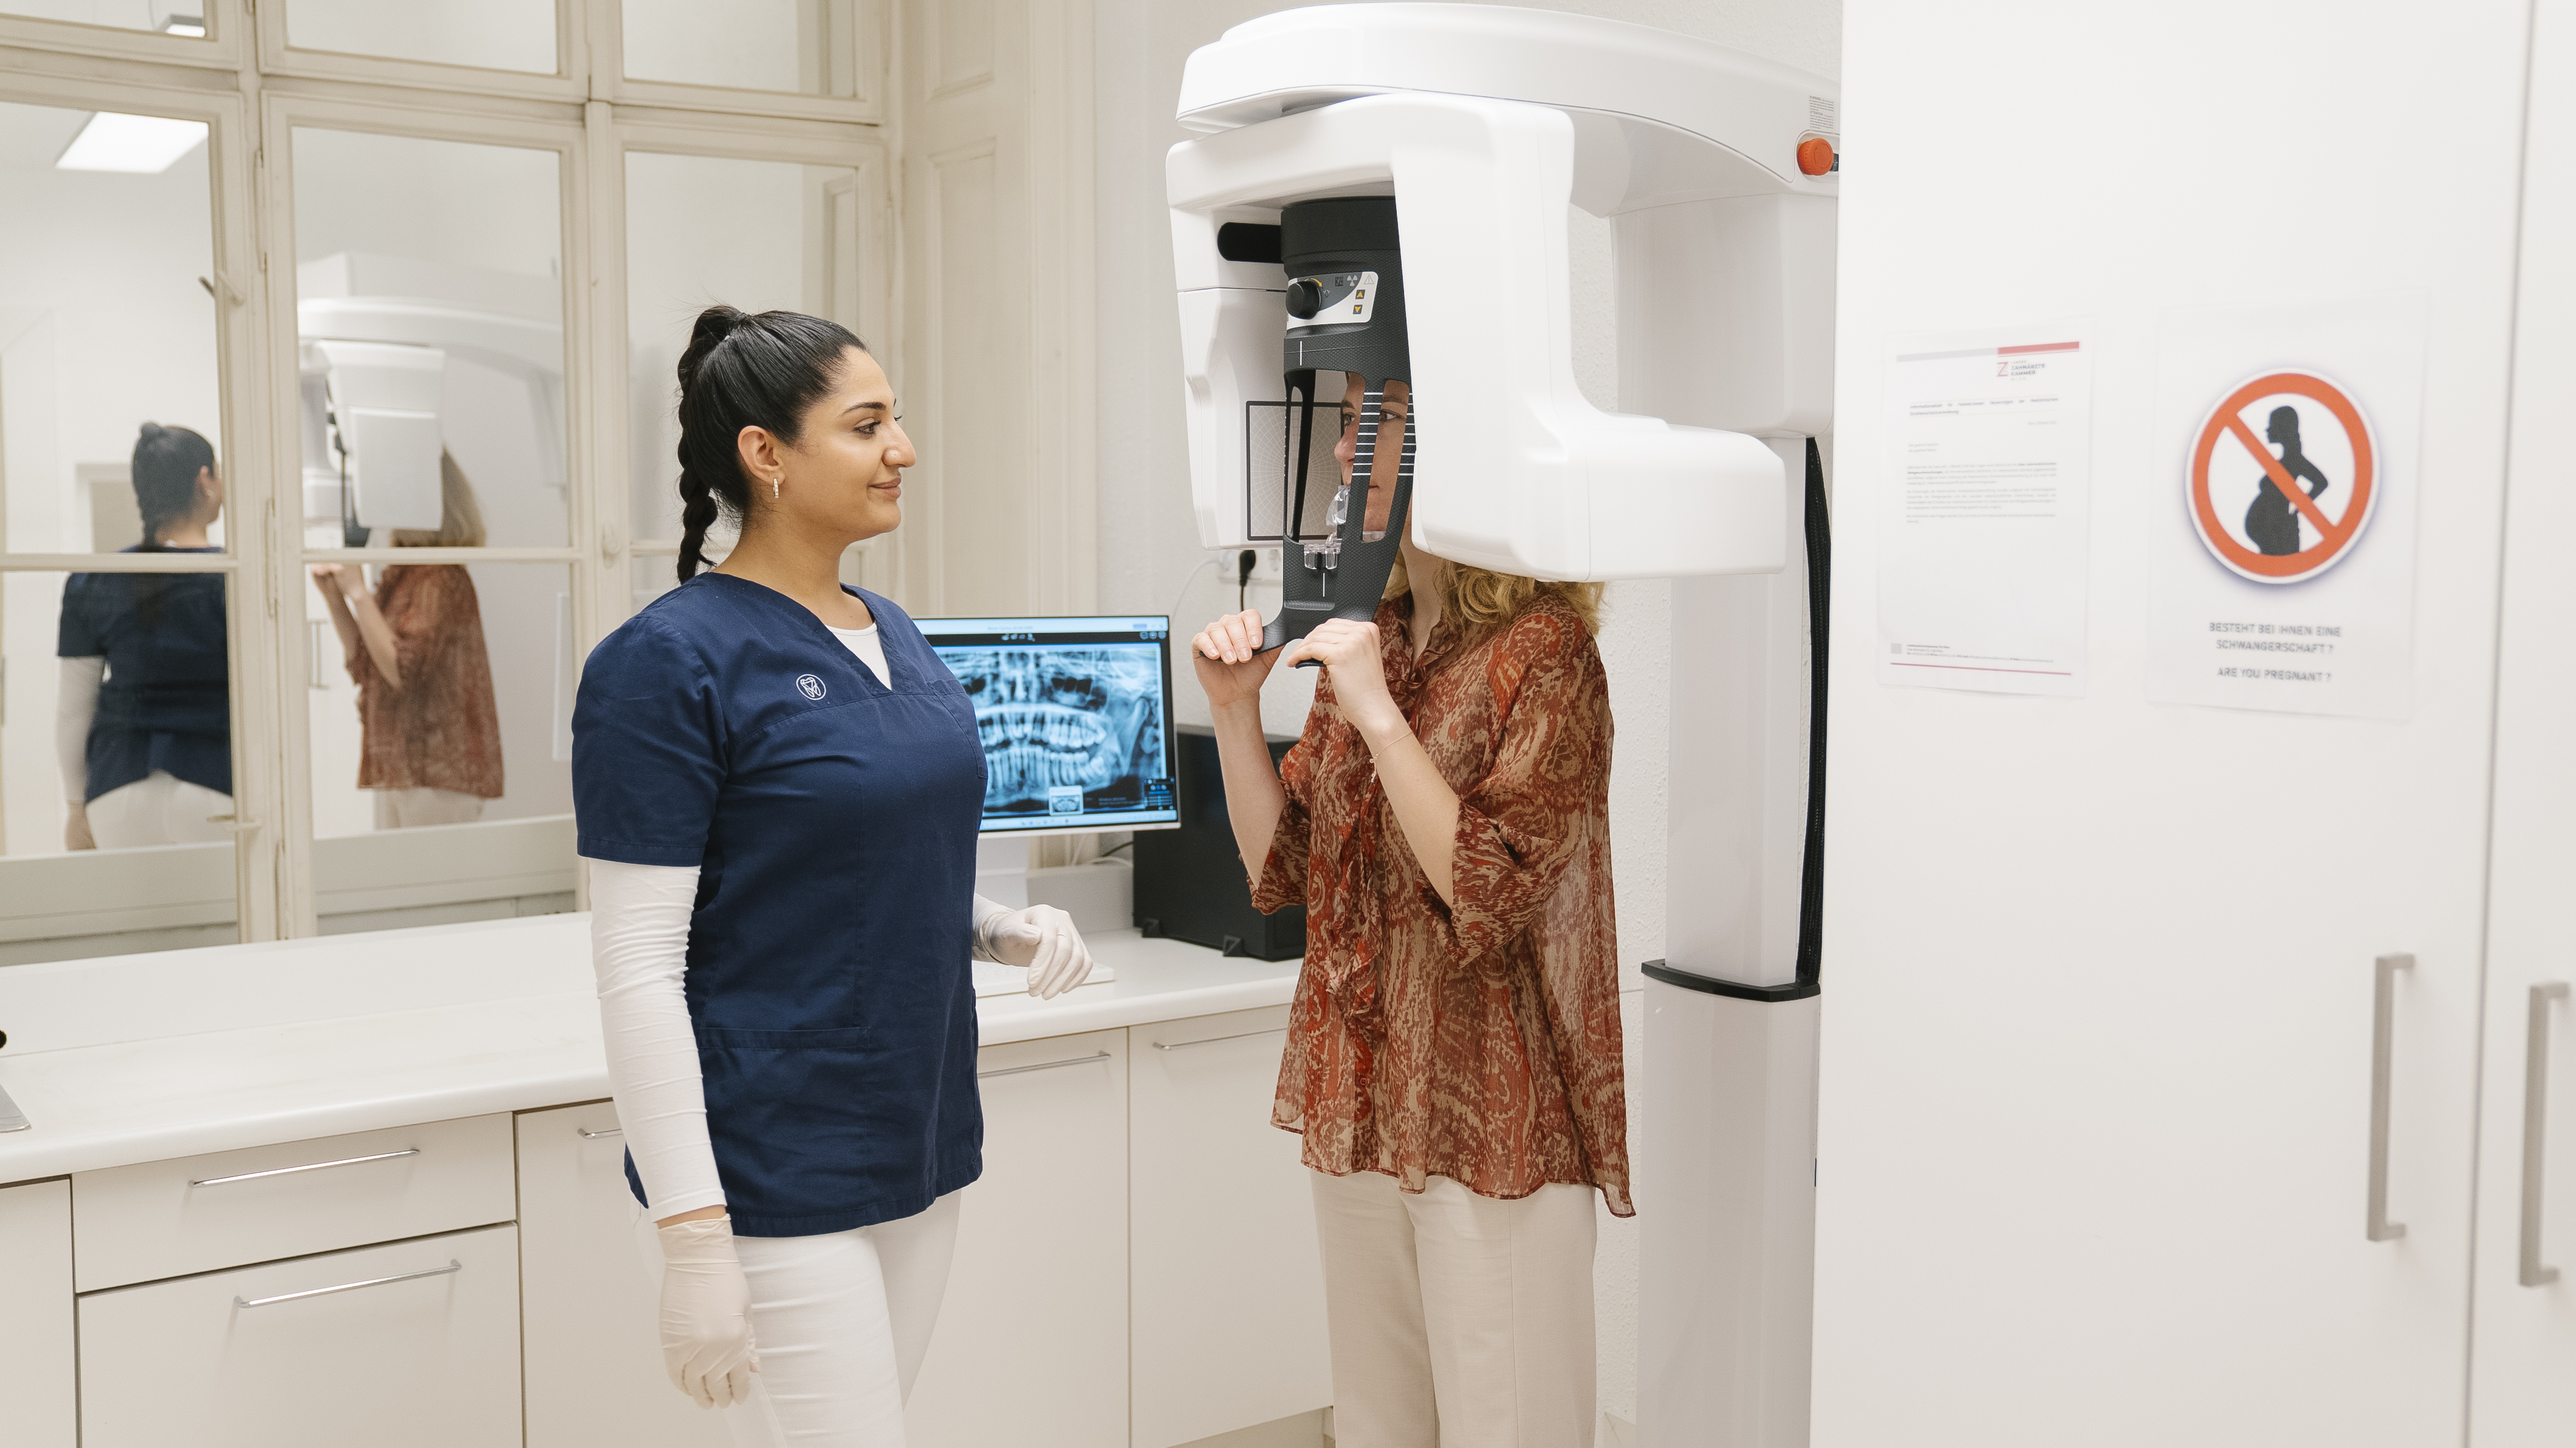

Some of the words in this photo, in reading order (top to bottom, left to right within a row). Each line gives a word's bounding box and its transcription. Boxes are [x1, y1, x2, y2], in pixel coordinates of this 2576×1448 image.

[2209, 622, 2255, 633] BESTEHT
[2258, 624, 2274, 634] BEI
[2278, 625, 2312, 636] IHNEN
[2316, 626, 2341, 637] EINE
[2217, 667, 2237, 677] ARE
[2240, 668, 2259, 679] YOU
